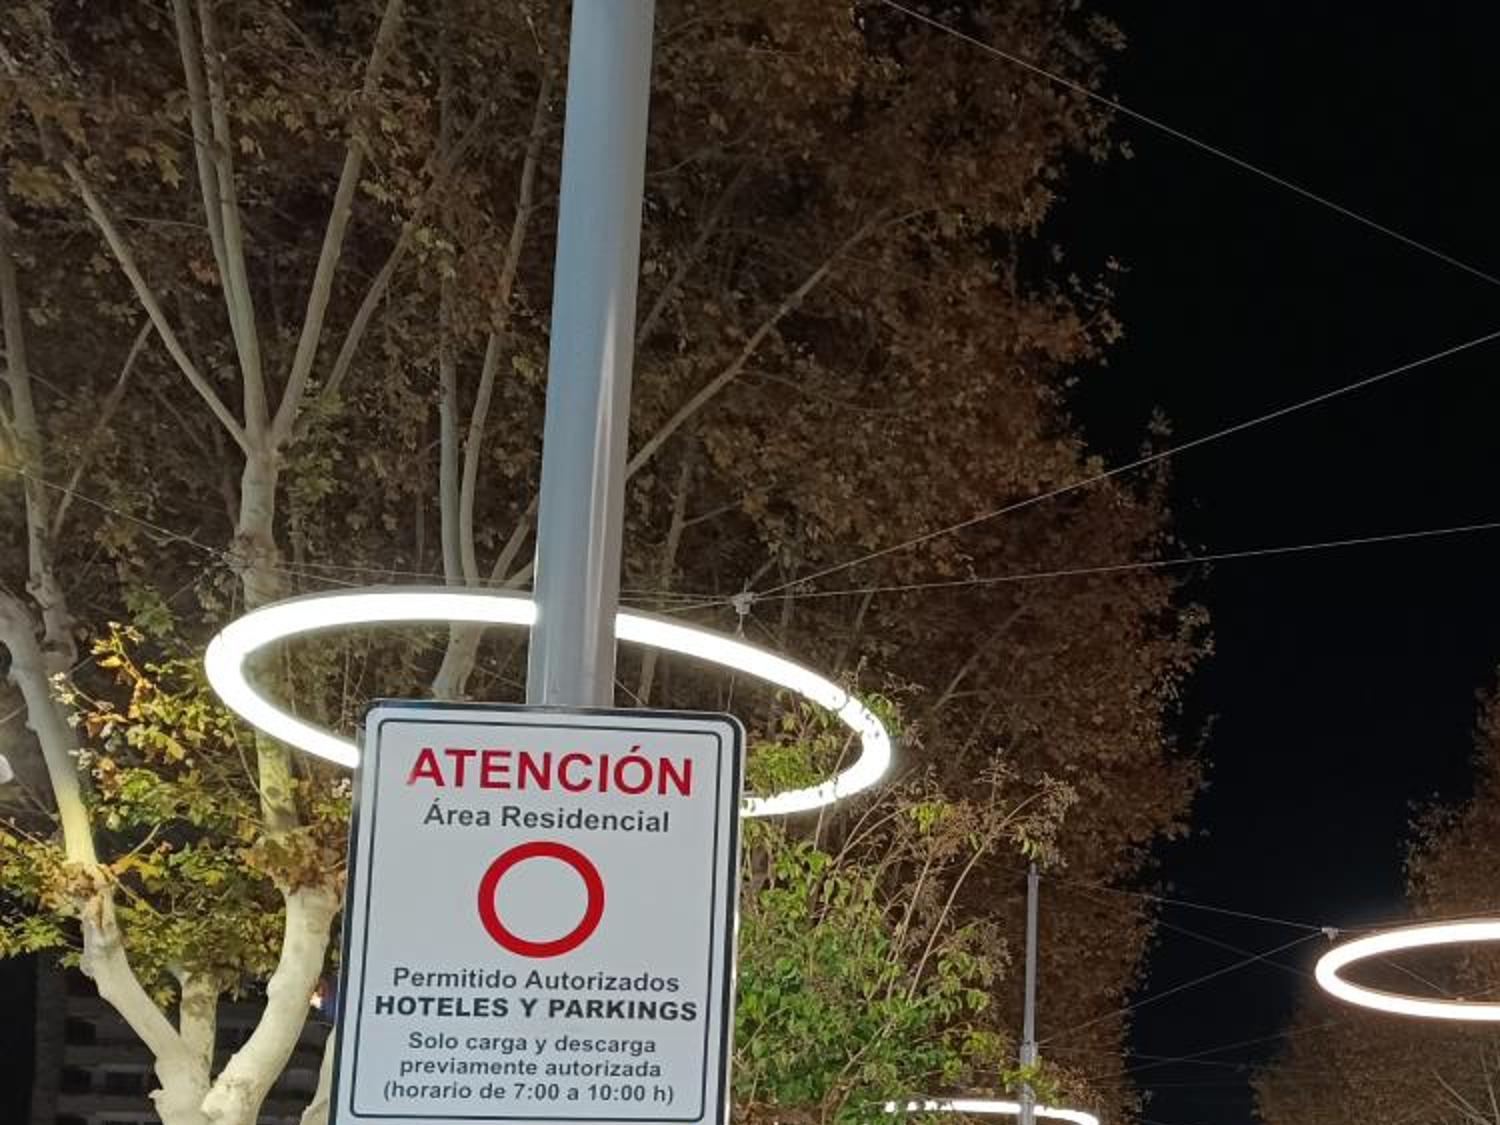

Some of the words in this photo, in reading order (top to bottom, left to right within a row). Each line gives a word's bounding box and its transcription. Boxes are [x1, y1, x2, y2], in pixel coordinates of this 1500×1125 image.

[406, 745, 693, 796] ATENCIÓN
[424, 798, 491, 827] Área
[501, 805, 669, 833] Residencial
[393, 967, 517, 990] Permitido
[525, 969, 680, 993] Autorizados
[375, 996, 509, 1018] HOTELES
[519, 998, 538, 1018] Y
[548, 998, 698, 1022] PARKINGS
[408, 1031, 459, 1050] Solo
[466, 1036, 528, 1055] carga
[535, 1039, 548, 1056] y
[554, 1035, 656, 1057] descarga
[400, 1058, 538, 1078] previamente
[545, 1060, 662, 1078] autorizada
[383, 1080, 472, 1102] (horario
[479, 1082, 505, 1100] de
[513, 1082, 560, 1101] 7:00
[567, 1086, 580, 1101] a
[587, 1083, 647, 1102] 10:00
[653, 1084, 675, 1105] h)
